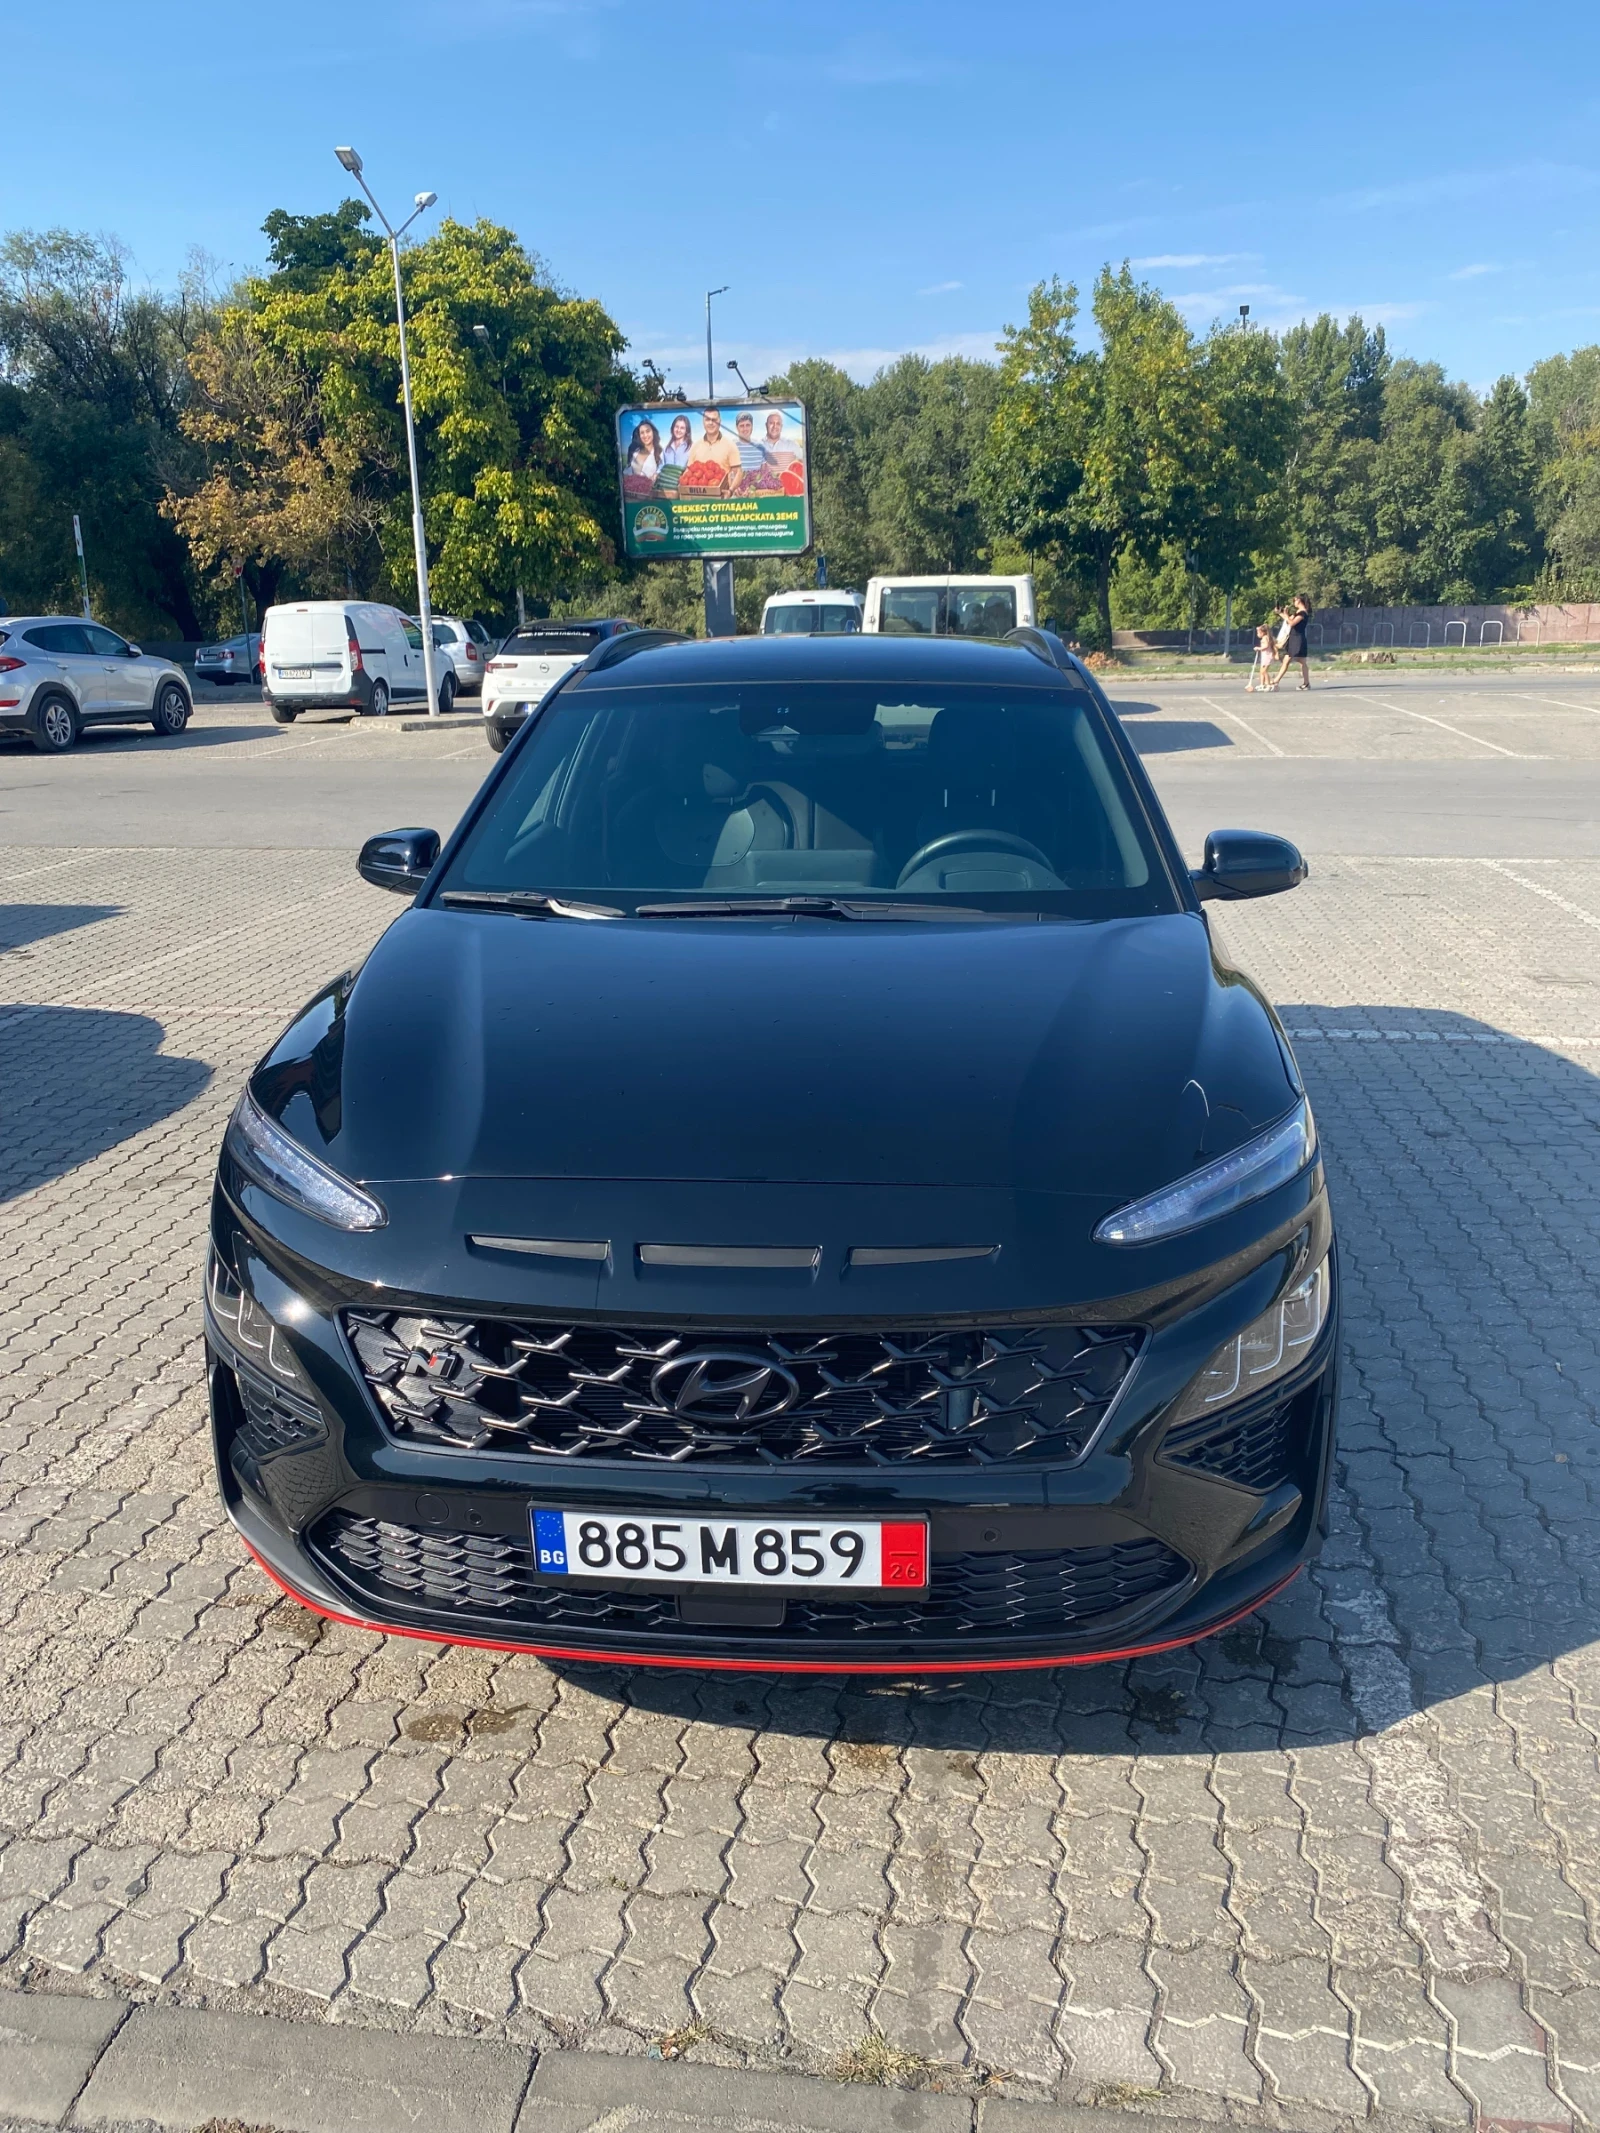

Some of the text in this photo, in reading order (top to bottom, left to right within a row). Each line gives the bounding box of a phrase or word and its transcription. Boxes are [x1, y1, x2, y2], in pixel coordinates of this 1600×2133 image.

[672, 502, 758, 513] СВЕЖЕСТ ОТГЛЕДАНА
[680, 516, 708, 524] ГРИЖА
[708, 515, 720, 523] ОТ
[720, 513, 775, 522] БЪЛГАРСКАТА
[776, 512, 798, 521] ЗЕМЯ
[540, 1549, 565, 1565] BG
[578, 1520, 866, 1579] 885 M 859
[889, 1562, 919, 1580] 26
